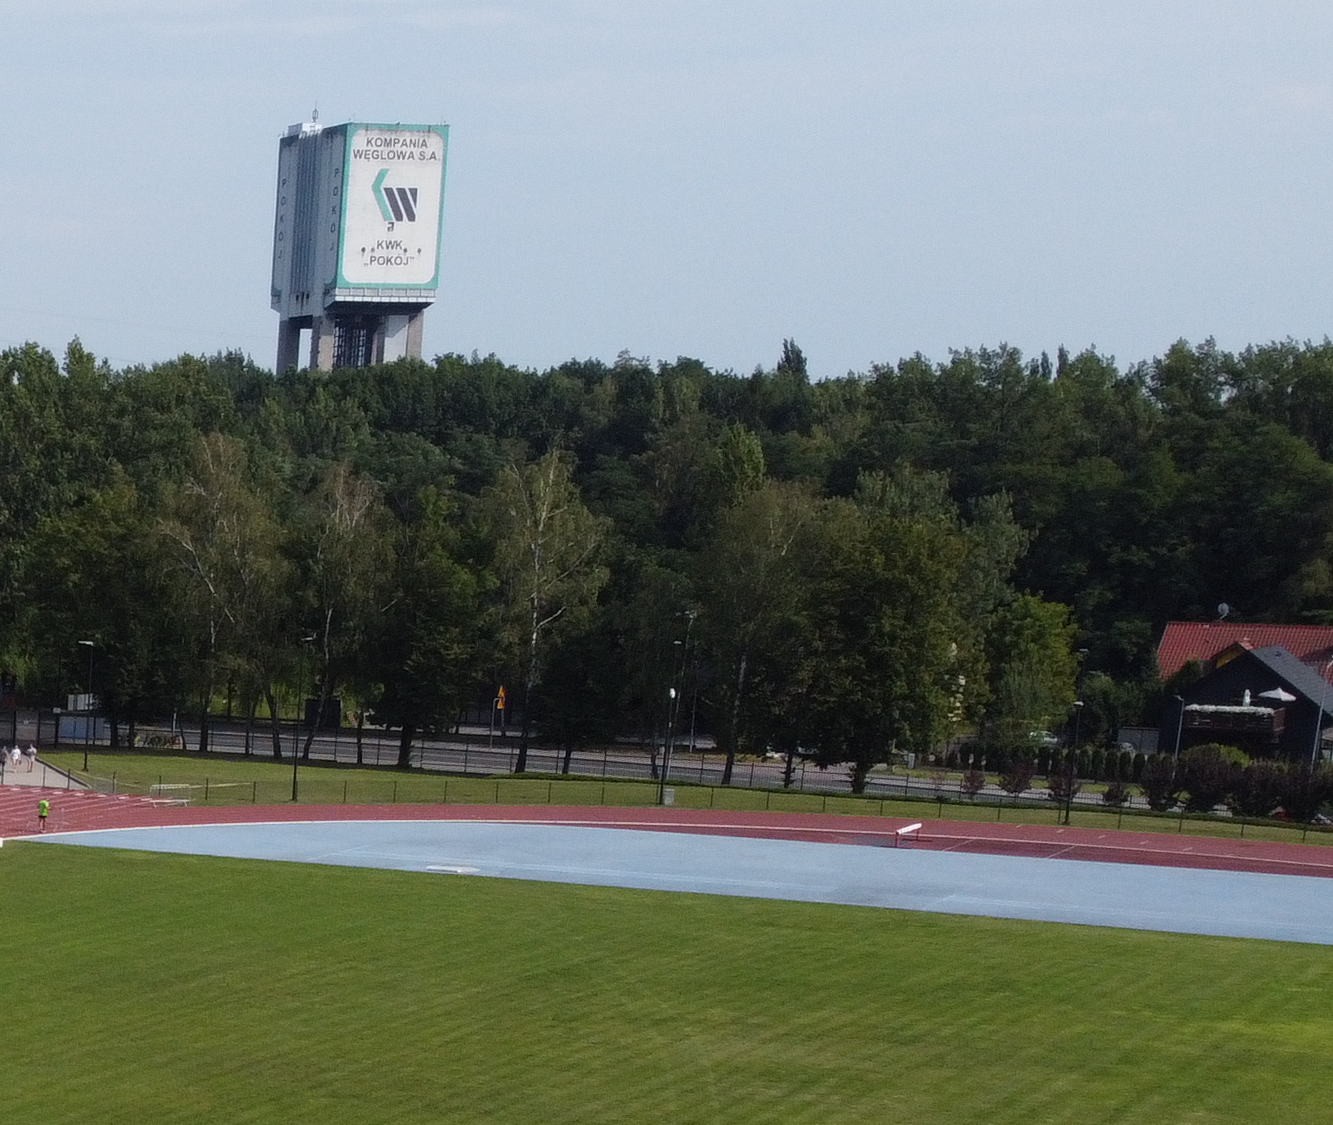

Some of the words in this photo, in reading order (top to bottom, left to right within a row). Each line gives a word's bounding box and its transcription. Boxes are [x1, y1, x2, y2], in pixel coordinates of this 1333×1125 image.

[366, 137, 428, 149] KOMPANIA
[353, 149, 415, 162] WĘGLOWA
[376, 240, 403, 250] KWK
